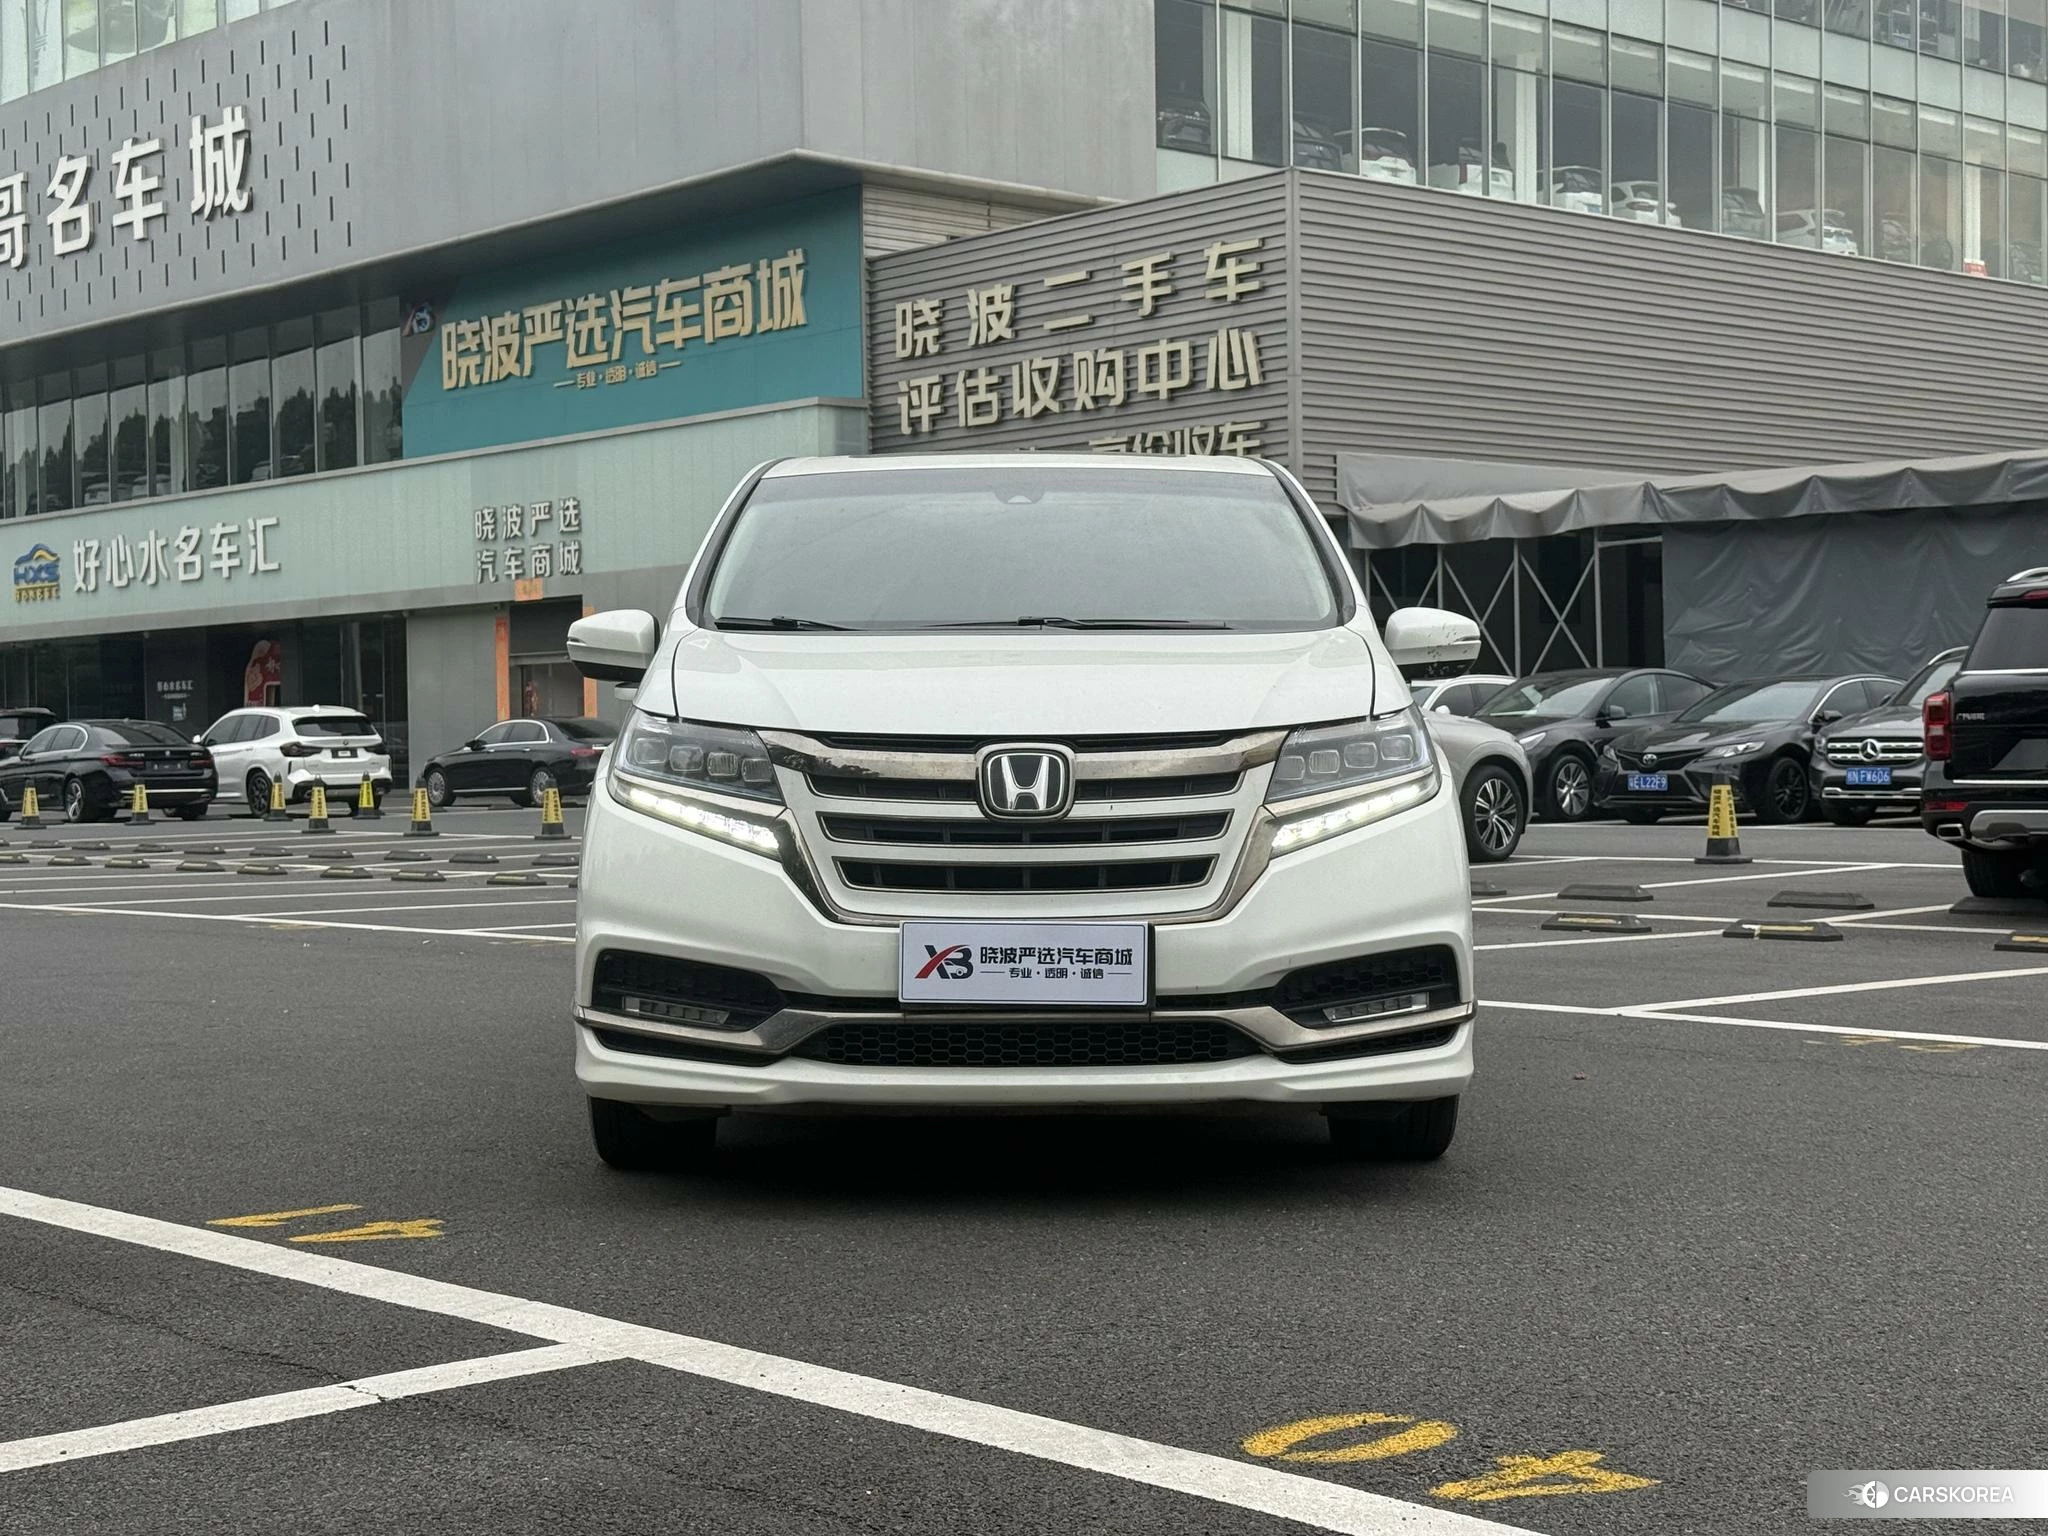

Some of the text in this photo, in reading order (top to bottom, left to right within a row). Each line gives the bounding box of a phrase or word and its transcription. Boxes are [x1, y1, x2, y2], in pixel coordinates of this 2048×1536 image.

[440, 248, 808, 390] 晓波严选汽车商城
[895, 238, 1264, 358] 晓波二手车
[897, 327, 1263, 435] 评估收购中心
[73, 517, 280, 592] 好心水名车汇
[474, 497, 580, 541] 晓波严选
[476, 541, 581, 584] 汽车商城
[980, 946, 1133, 966] 晓波严选汽车商城
